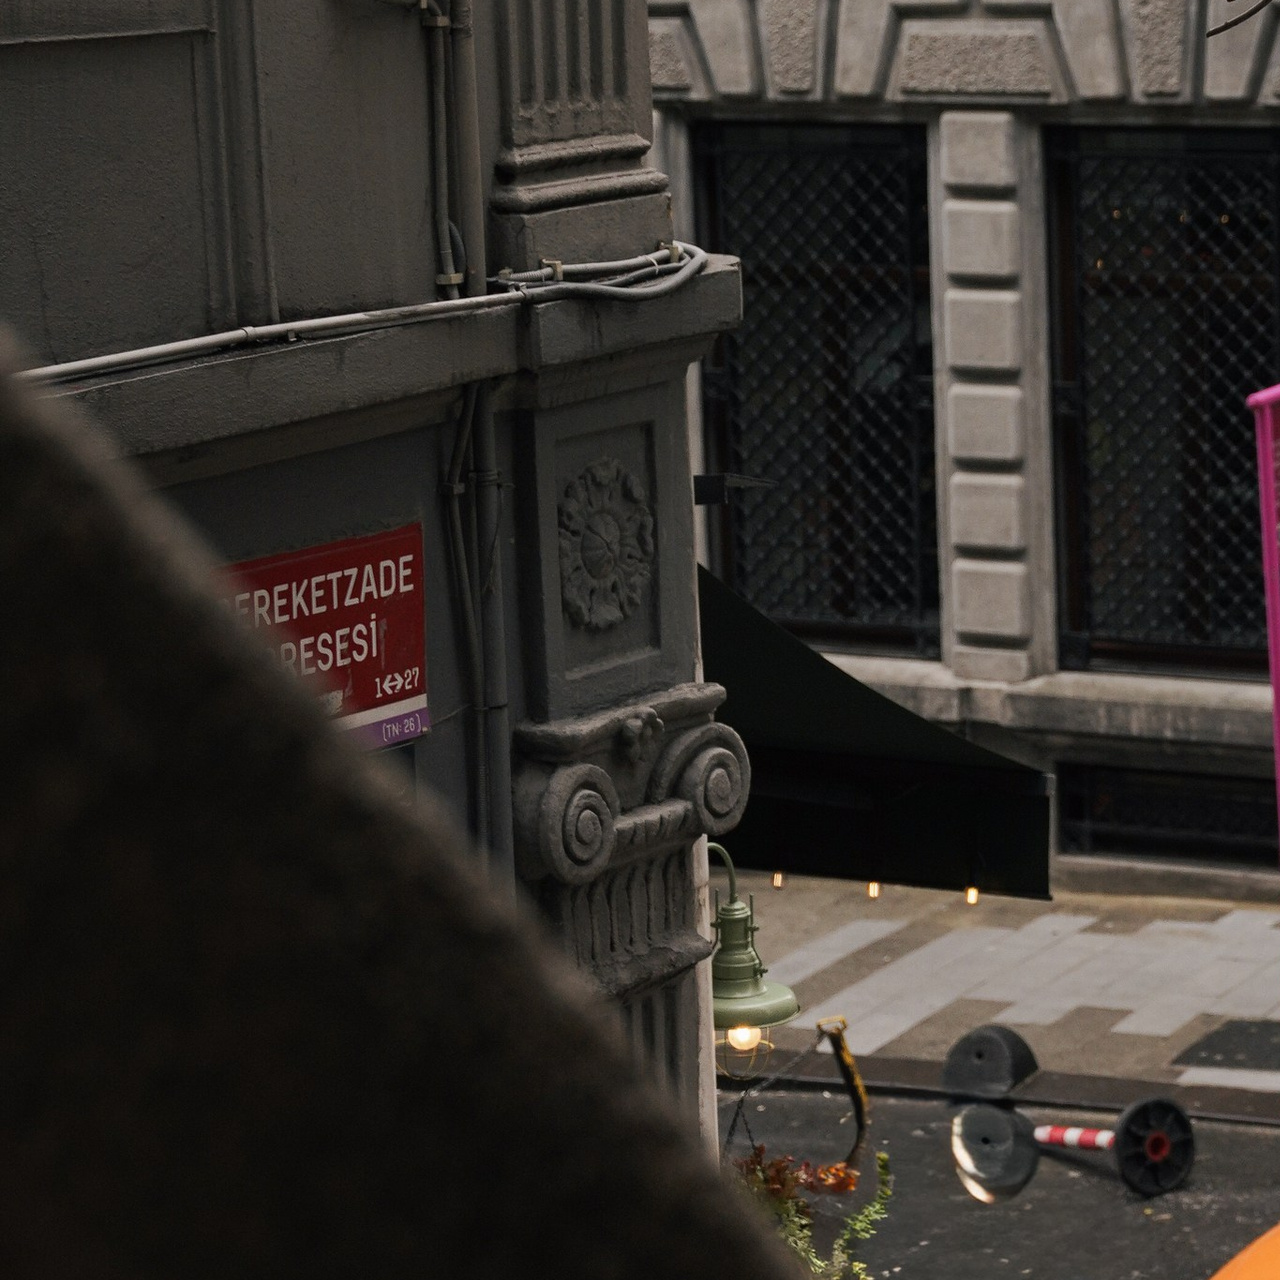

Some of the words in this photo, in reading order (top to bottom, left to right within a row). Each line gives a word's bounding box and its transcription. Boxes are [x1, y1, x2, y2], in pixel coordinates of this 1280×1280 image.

[224, 554, 415, 629] EREKETZADE
[273, 613, 378, 677] RESESİ
[404, 667, 420, 690] 27
